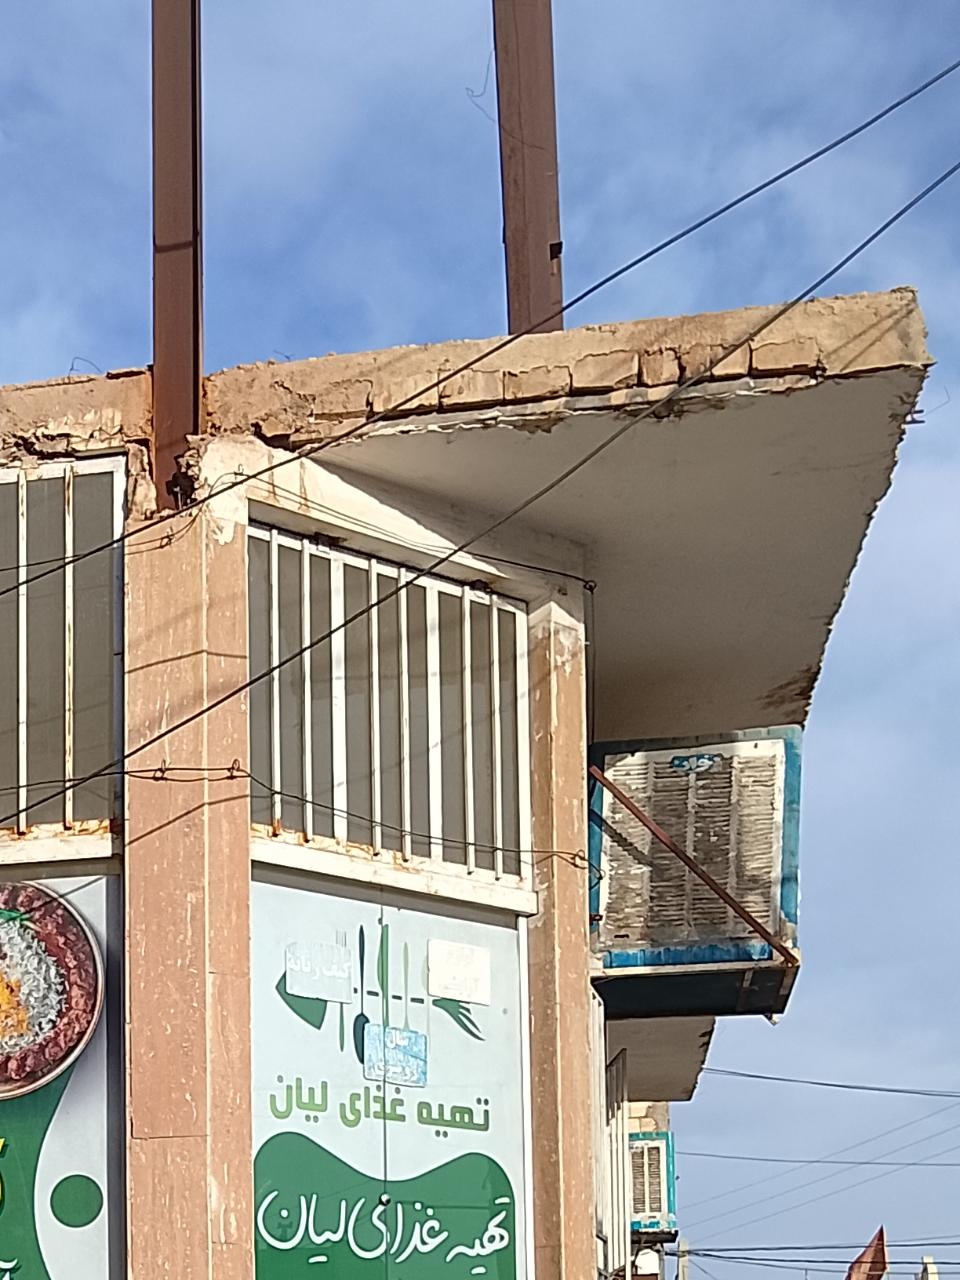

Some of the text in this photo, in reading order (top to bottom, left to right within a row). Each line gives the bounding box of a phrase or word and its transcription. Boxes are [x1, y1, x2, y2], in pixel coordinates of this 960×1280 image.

[270, 1075, 490, 1138] تهیه غذای لیان
[257, 1190, 511, 1275] تهیه غذای لیان
